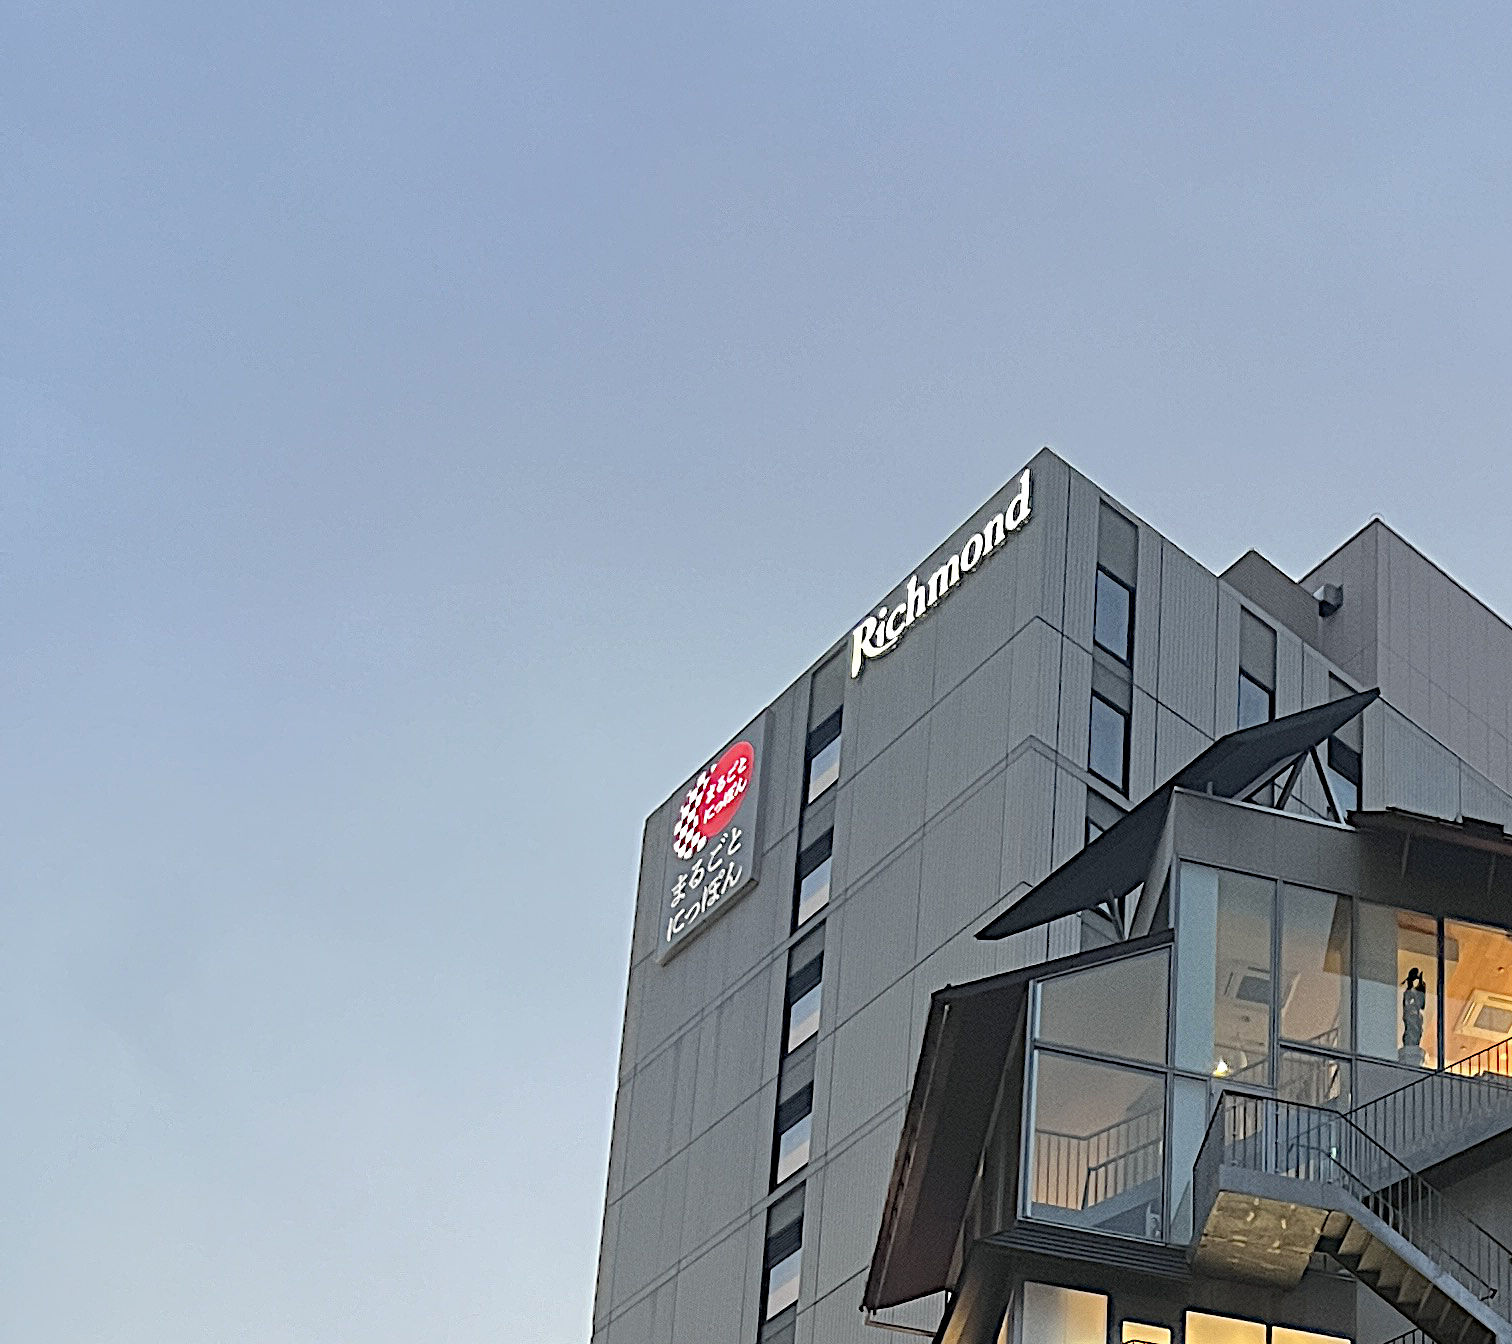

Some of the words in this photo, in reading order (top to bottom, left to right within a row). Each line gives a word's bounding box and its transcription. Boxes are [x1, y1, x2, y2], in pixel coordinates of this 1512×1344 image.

[851, 467, 1032, 679] Richmond
[706, 757, 747, 804] まるごと
[666, 862, 743, 942] にっぽん
[670, 828, 741, 908] まるごと
